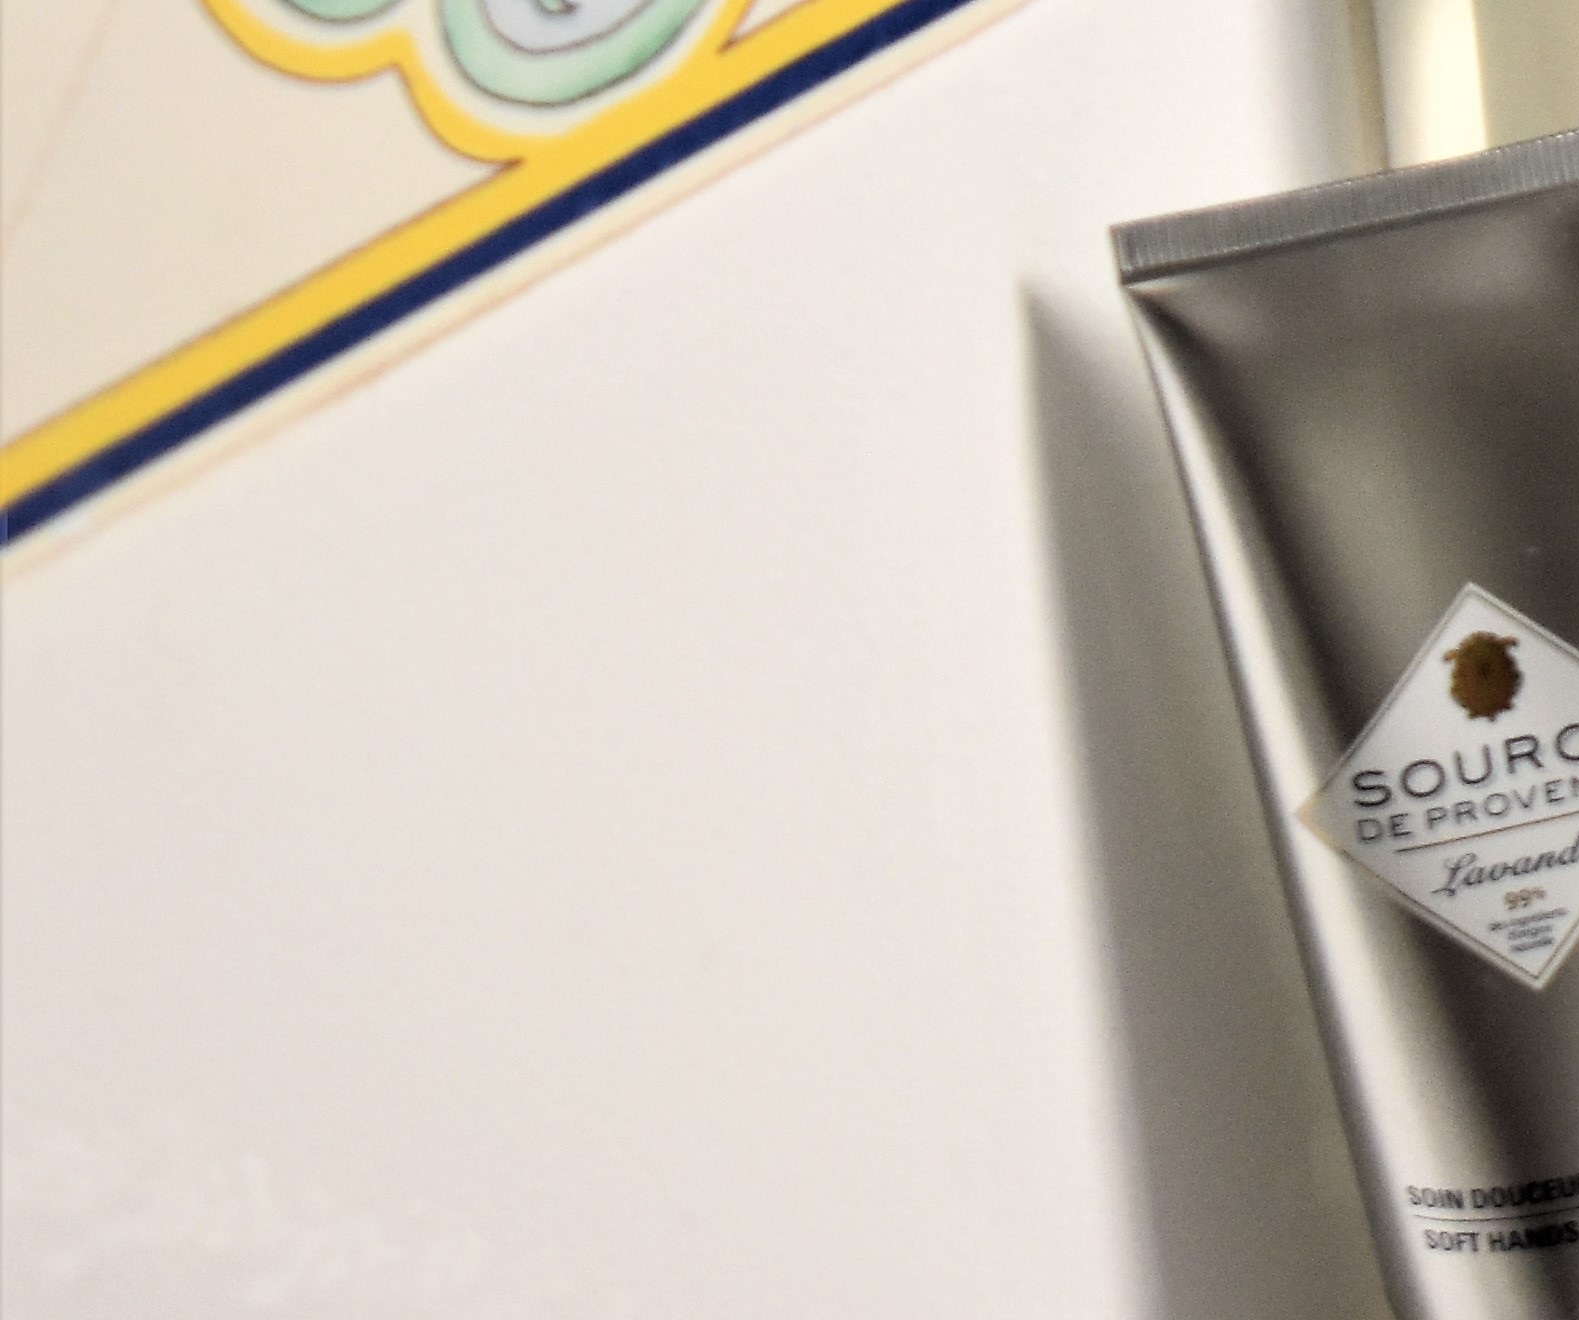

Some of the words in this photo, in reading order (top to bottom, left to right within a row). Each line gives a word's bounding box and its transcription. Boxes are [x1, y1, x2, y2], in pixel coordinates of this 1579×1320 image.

[1356, 812, 1411, 845] DE
[1406, 1184, 1464, 1210] SOIN
[1422, 1227, 1480, 1253] SOFT
